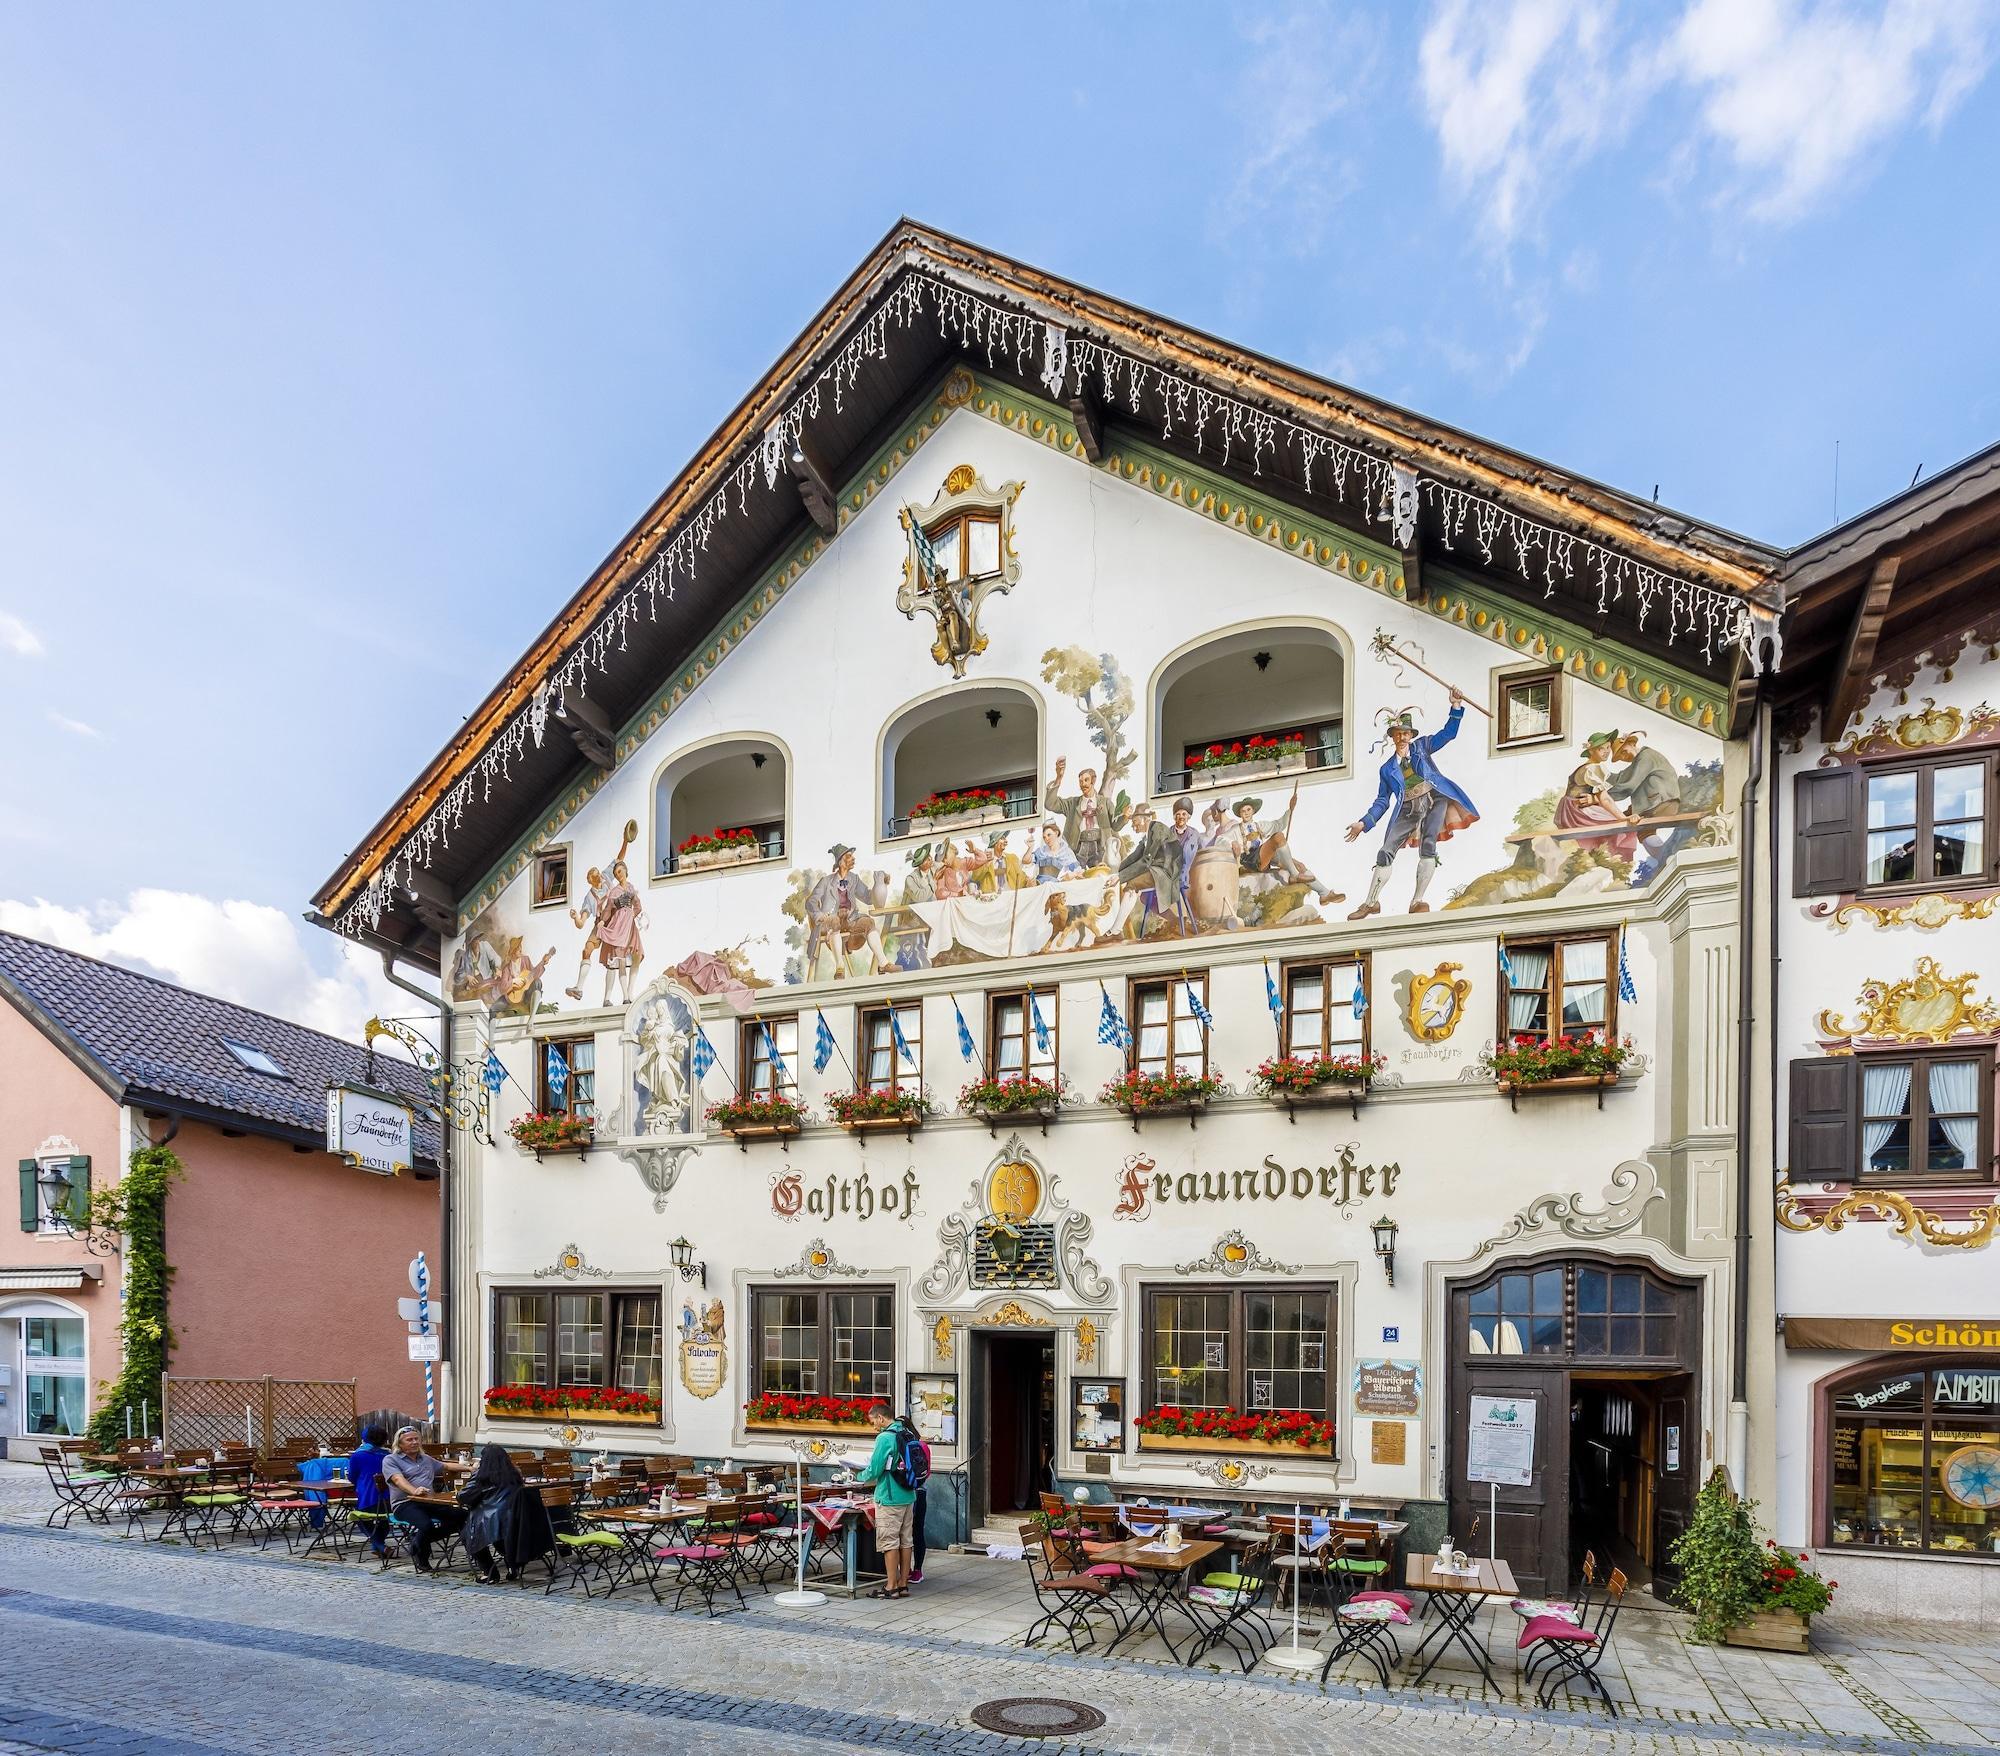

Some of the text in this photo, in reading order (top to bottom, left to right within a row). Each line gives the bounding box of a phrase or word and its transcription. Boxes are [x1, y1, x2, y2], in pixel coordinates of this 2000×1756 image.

[330, 1090, 338, 1149] HOTEL
[369, 1110, 404, 1132] Gasthof
[362, 1156, 392, 1170] HOTEL
[1112, 1141, 1402, 1223] Fraundorfer
[1386, 1329, 1396, 1337] 24
[1890, 1321, 2000, 1347] Schön
[687, 1346, 720, 1358] Salvator
[1373, 1384, 1402, 1393] Abend
[1853, 1379, 1913, 1410] Bergkäse
